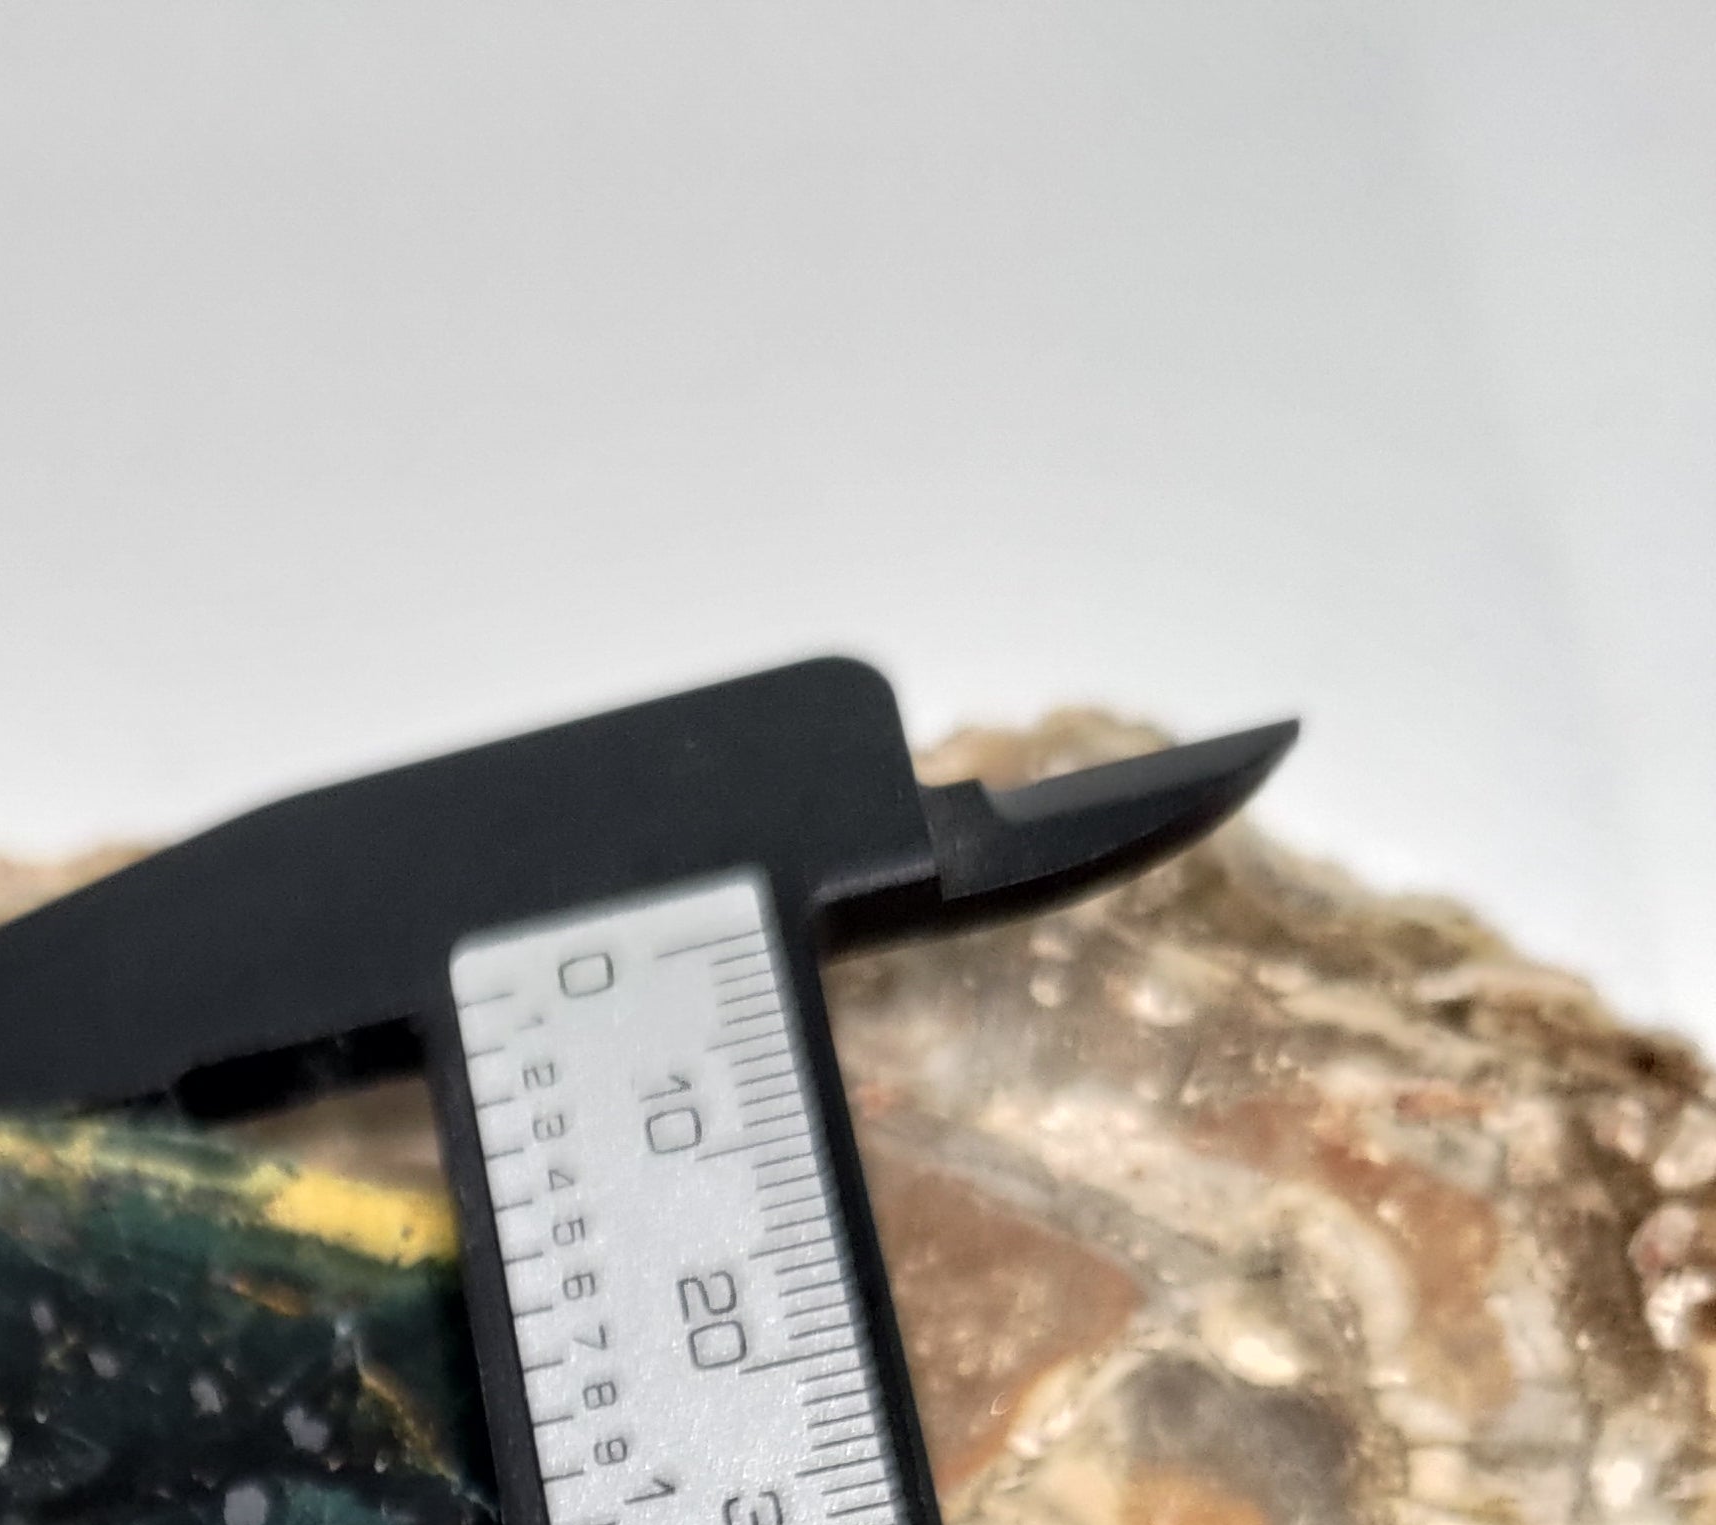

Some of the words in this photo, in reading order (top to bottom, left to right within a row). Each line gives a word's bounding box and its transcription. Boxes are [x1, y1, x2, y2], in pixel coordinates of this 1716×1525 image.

[522, 1061, 555, 1089] 2
[532, 1112, 565, 1139] 3
[558, 952, 614, 999] 0
[639, 1073, 703, 1155] 10
[676, 1270, 748, 1371] 20
[546, 1168, 576, 1191] 4
[552, 1216, 587, 1248] 5
[562, 1270, 596, 1301] 6
[572, 1323, 606, 1354] 7
[582, 1379, 616, 1409] 8
[593, 1436, 628, 1466] 9
[623, 1476, 676, 1506] 1
